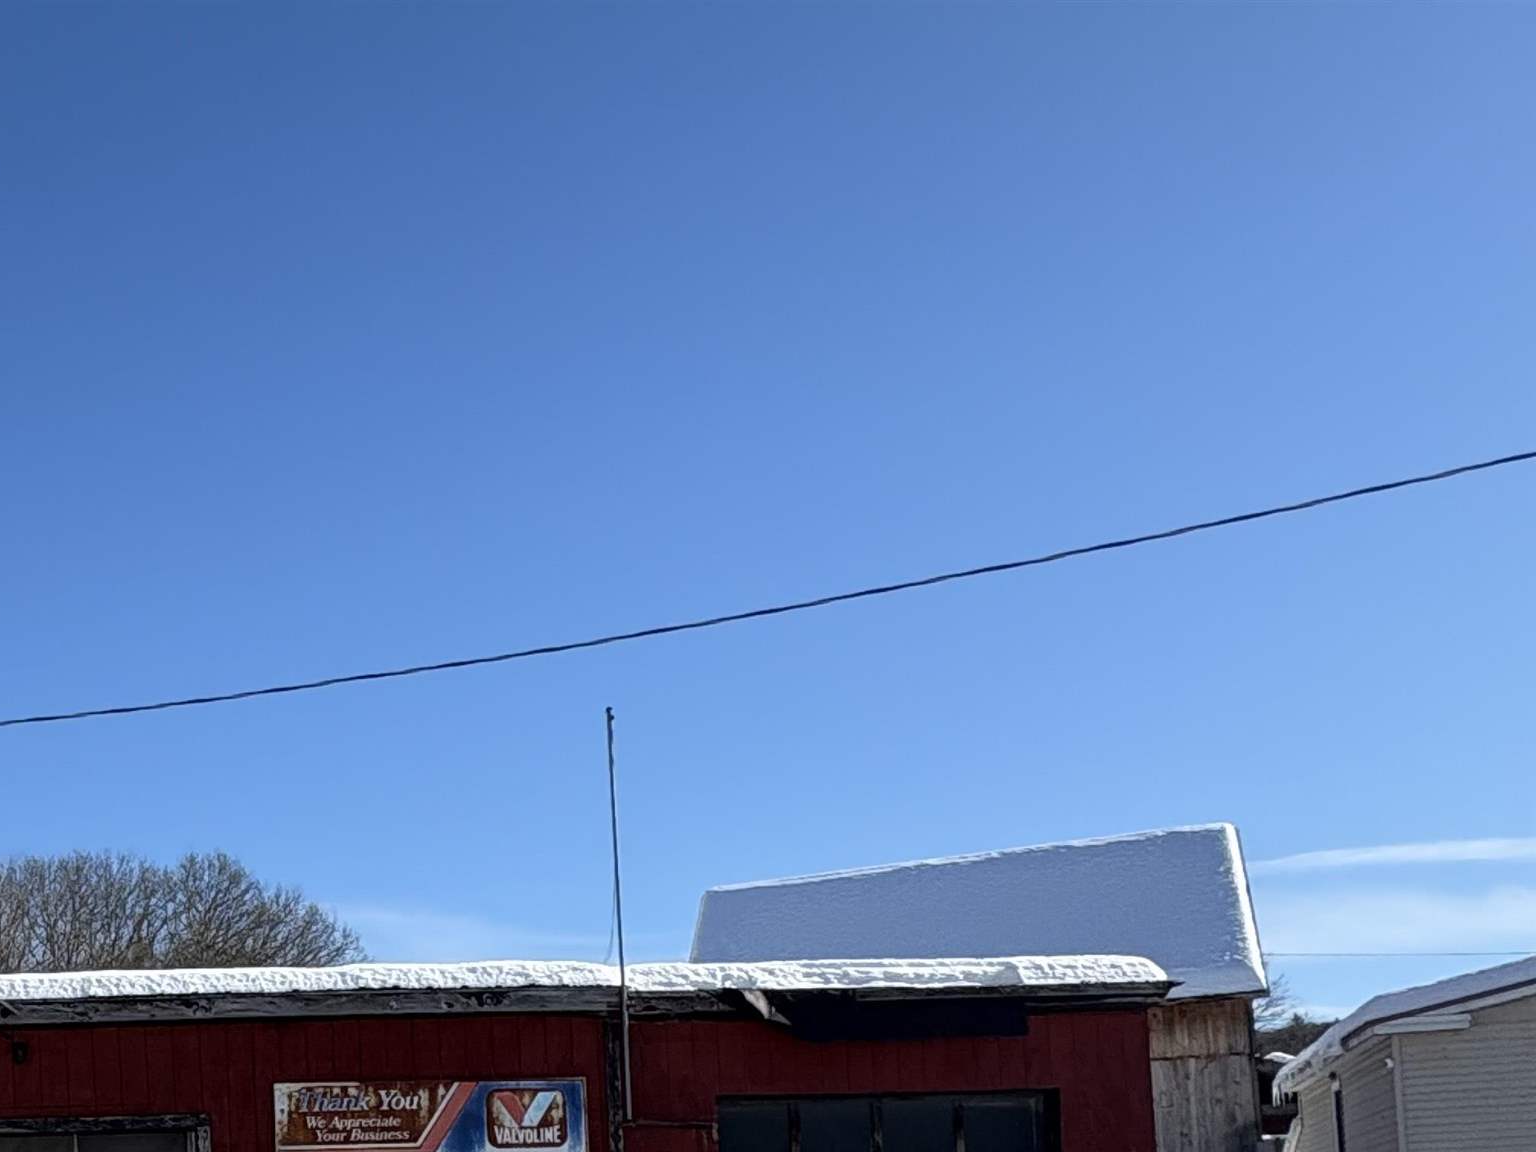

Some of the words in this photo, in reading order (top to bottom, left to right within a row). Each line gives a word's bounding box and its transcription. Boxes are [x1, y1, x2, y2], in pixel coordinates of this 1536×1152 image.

[298, 1087, 370, 1112] Thank
[378, 1090, 420, 1111] You
[306, 1116, 326, 1129] We
[329, 1115, 402, 1131] Appreciate
[315, 1129, 347, 1142] Your
[349, 1129, 410, 1142] Business
[494, 1125, 562, 1144] VALVOLINE
